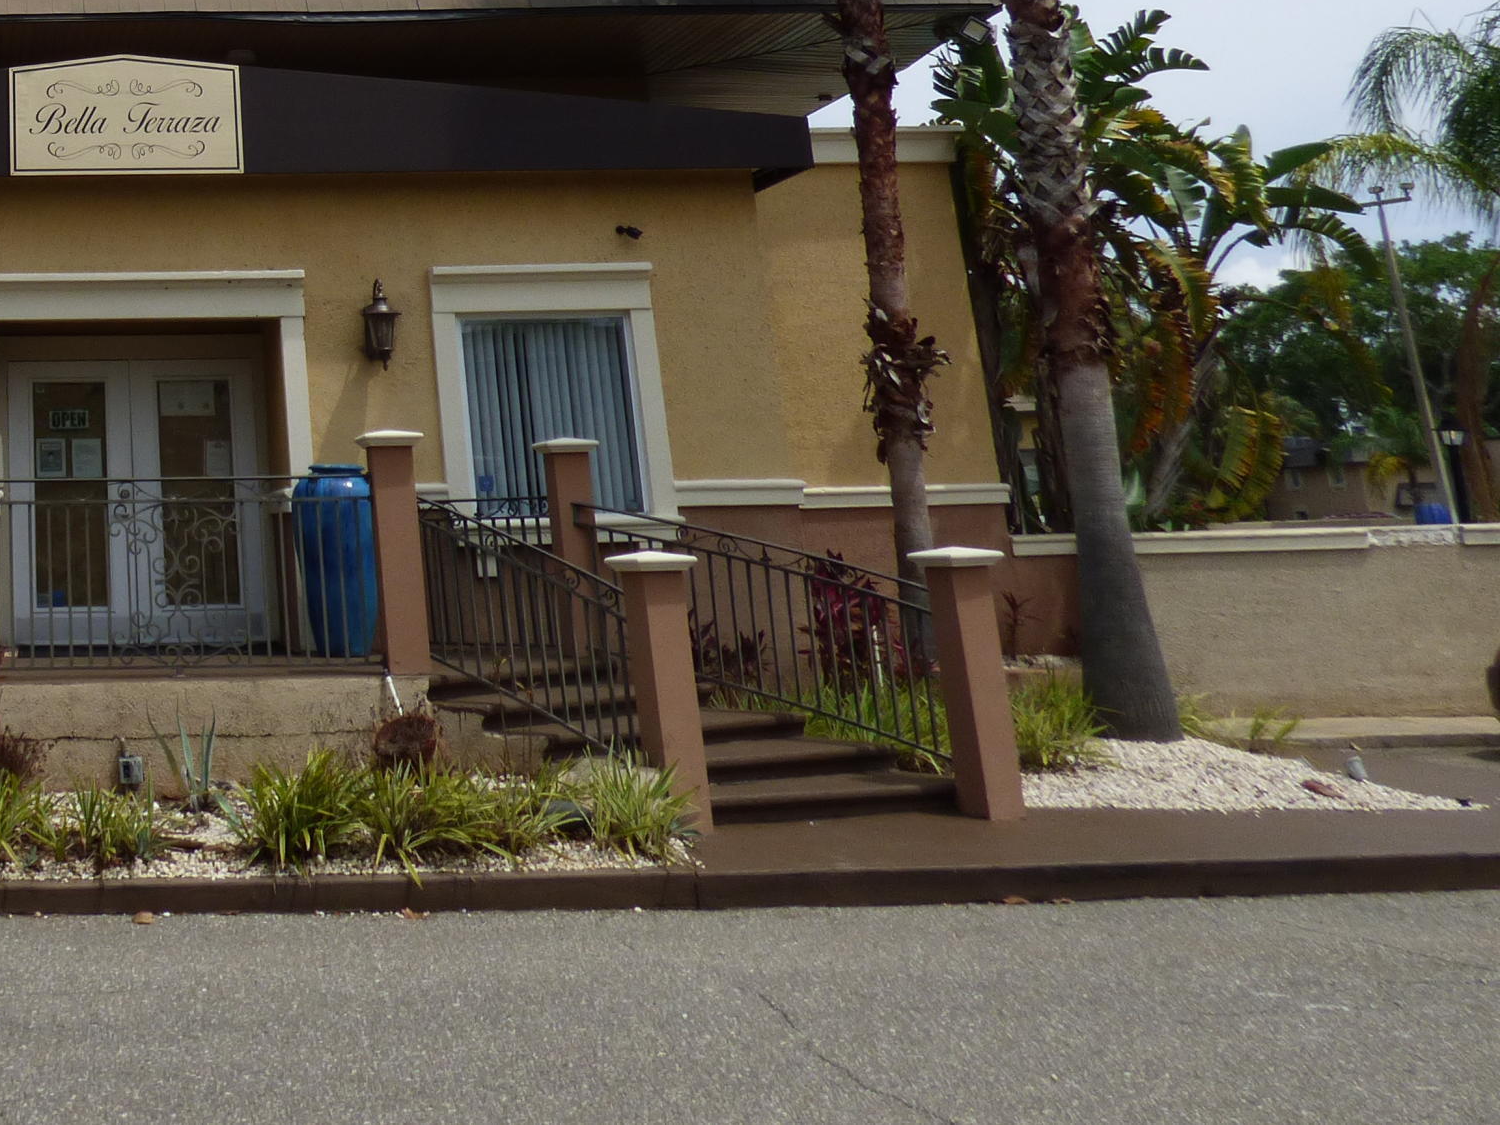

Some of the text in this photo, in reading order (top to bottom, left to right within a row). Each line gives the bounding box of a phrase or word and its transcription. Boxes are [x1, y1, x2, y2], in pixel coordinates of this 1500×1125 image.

[28, 101, 220, 135] Bella Terraza
[51, 411, 86, 428] OPEN
